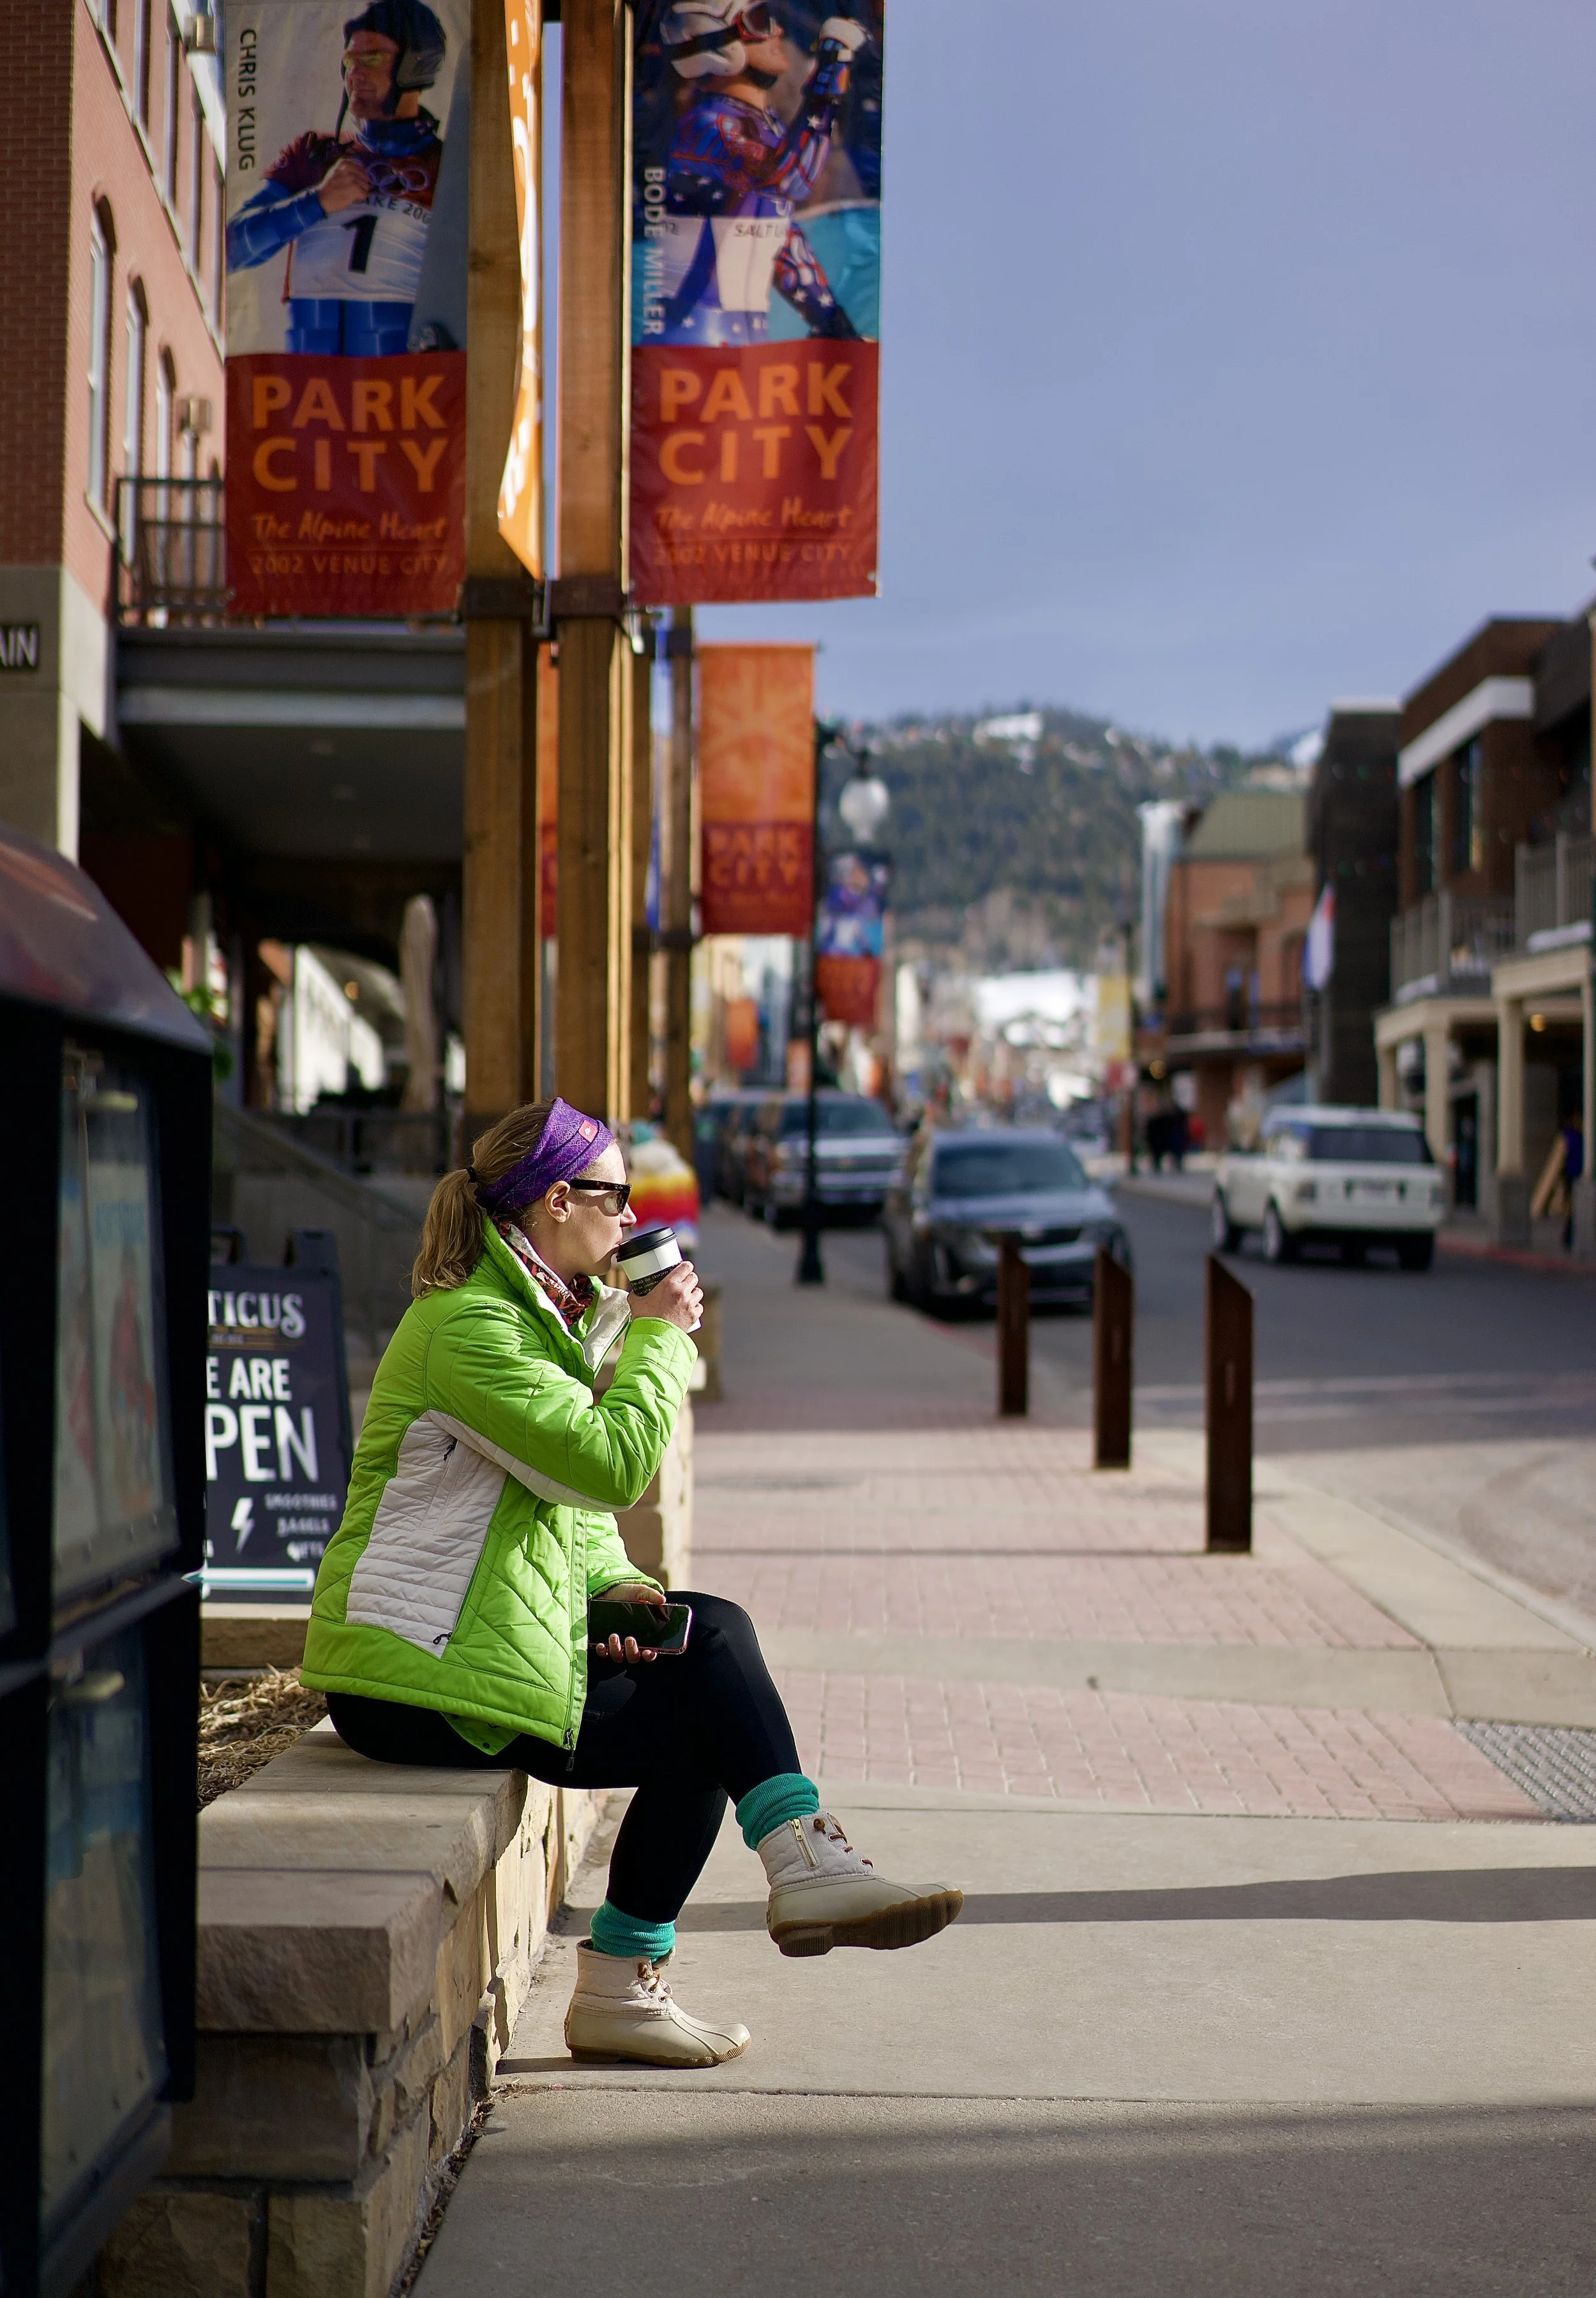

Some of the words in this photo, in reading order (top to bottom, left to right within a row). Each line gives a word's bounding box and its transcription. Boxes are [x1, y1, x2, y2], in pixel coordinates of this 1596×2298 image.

[237, 29, 257, 98] CHRIS
[238, 107, 255, 171] KLUG
[644, 168, 666, 239] BODE
[344, 214, 379, 274] 1
[644, 249, 666, 335] MILLER
[252, 375, 448, 432] PARK
[659, 361, 854, 423] PARK
[252, 437, 448, 493] CITY
[659, 425, 854, 486] CITY
[252, 513, 290, 539] The
[298, 509, 371, 543] Alpine
[380, 511, 446, 539] Heart
[658, 506, 693, 529] The
[702, 501, 771, 534] Alpine
[782, 497, 852, 528] Heart
[312, 554, 392, 574] VENUE
[400, 553, 448, 574] CITY
[714, 543, 792, 563] VENUE
[801, 543, 852, 562] CITY
[709, 859, 799, 887] CITY
[229, 1356, 293, 1402] ARE
[206, 1404, 319, 1482] PEN
